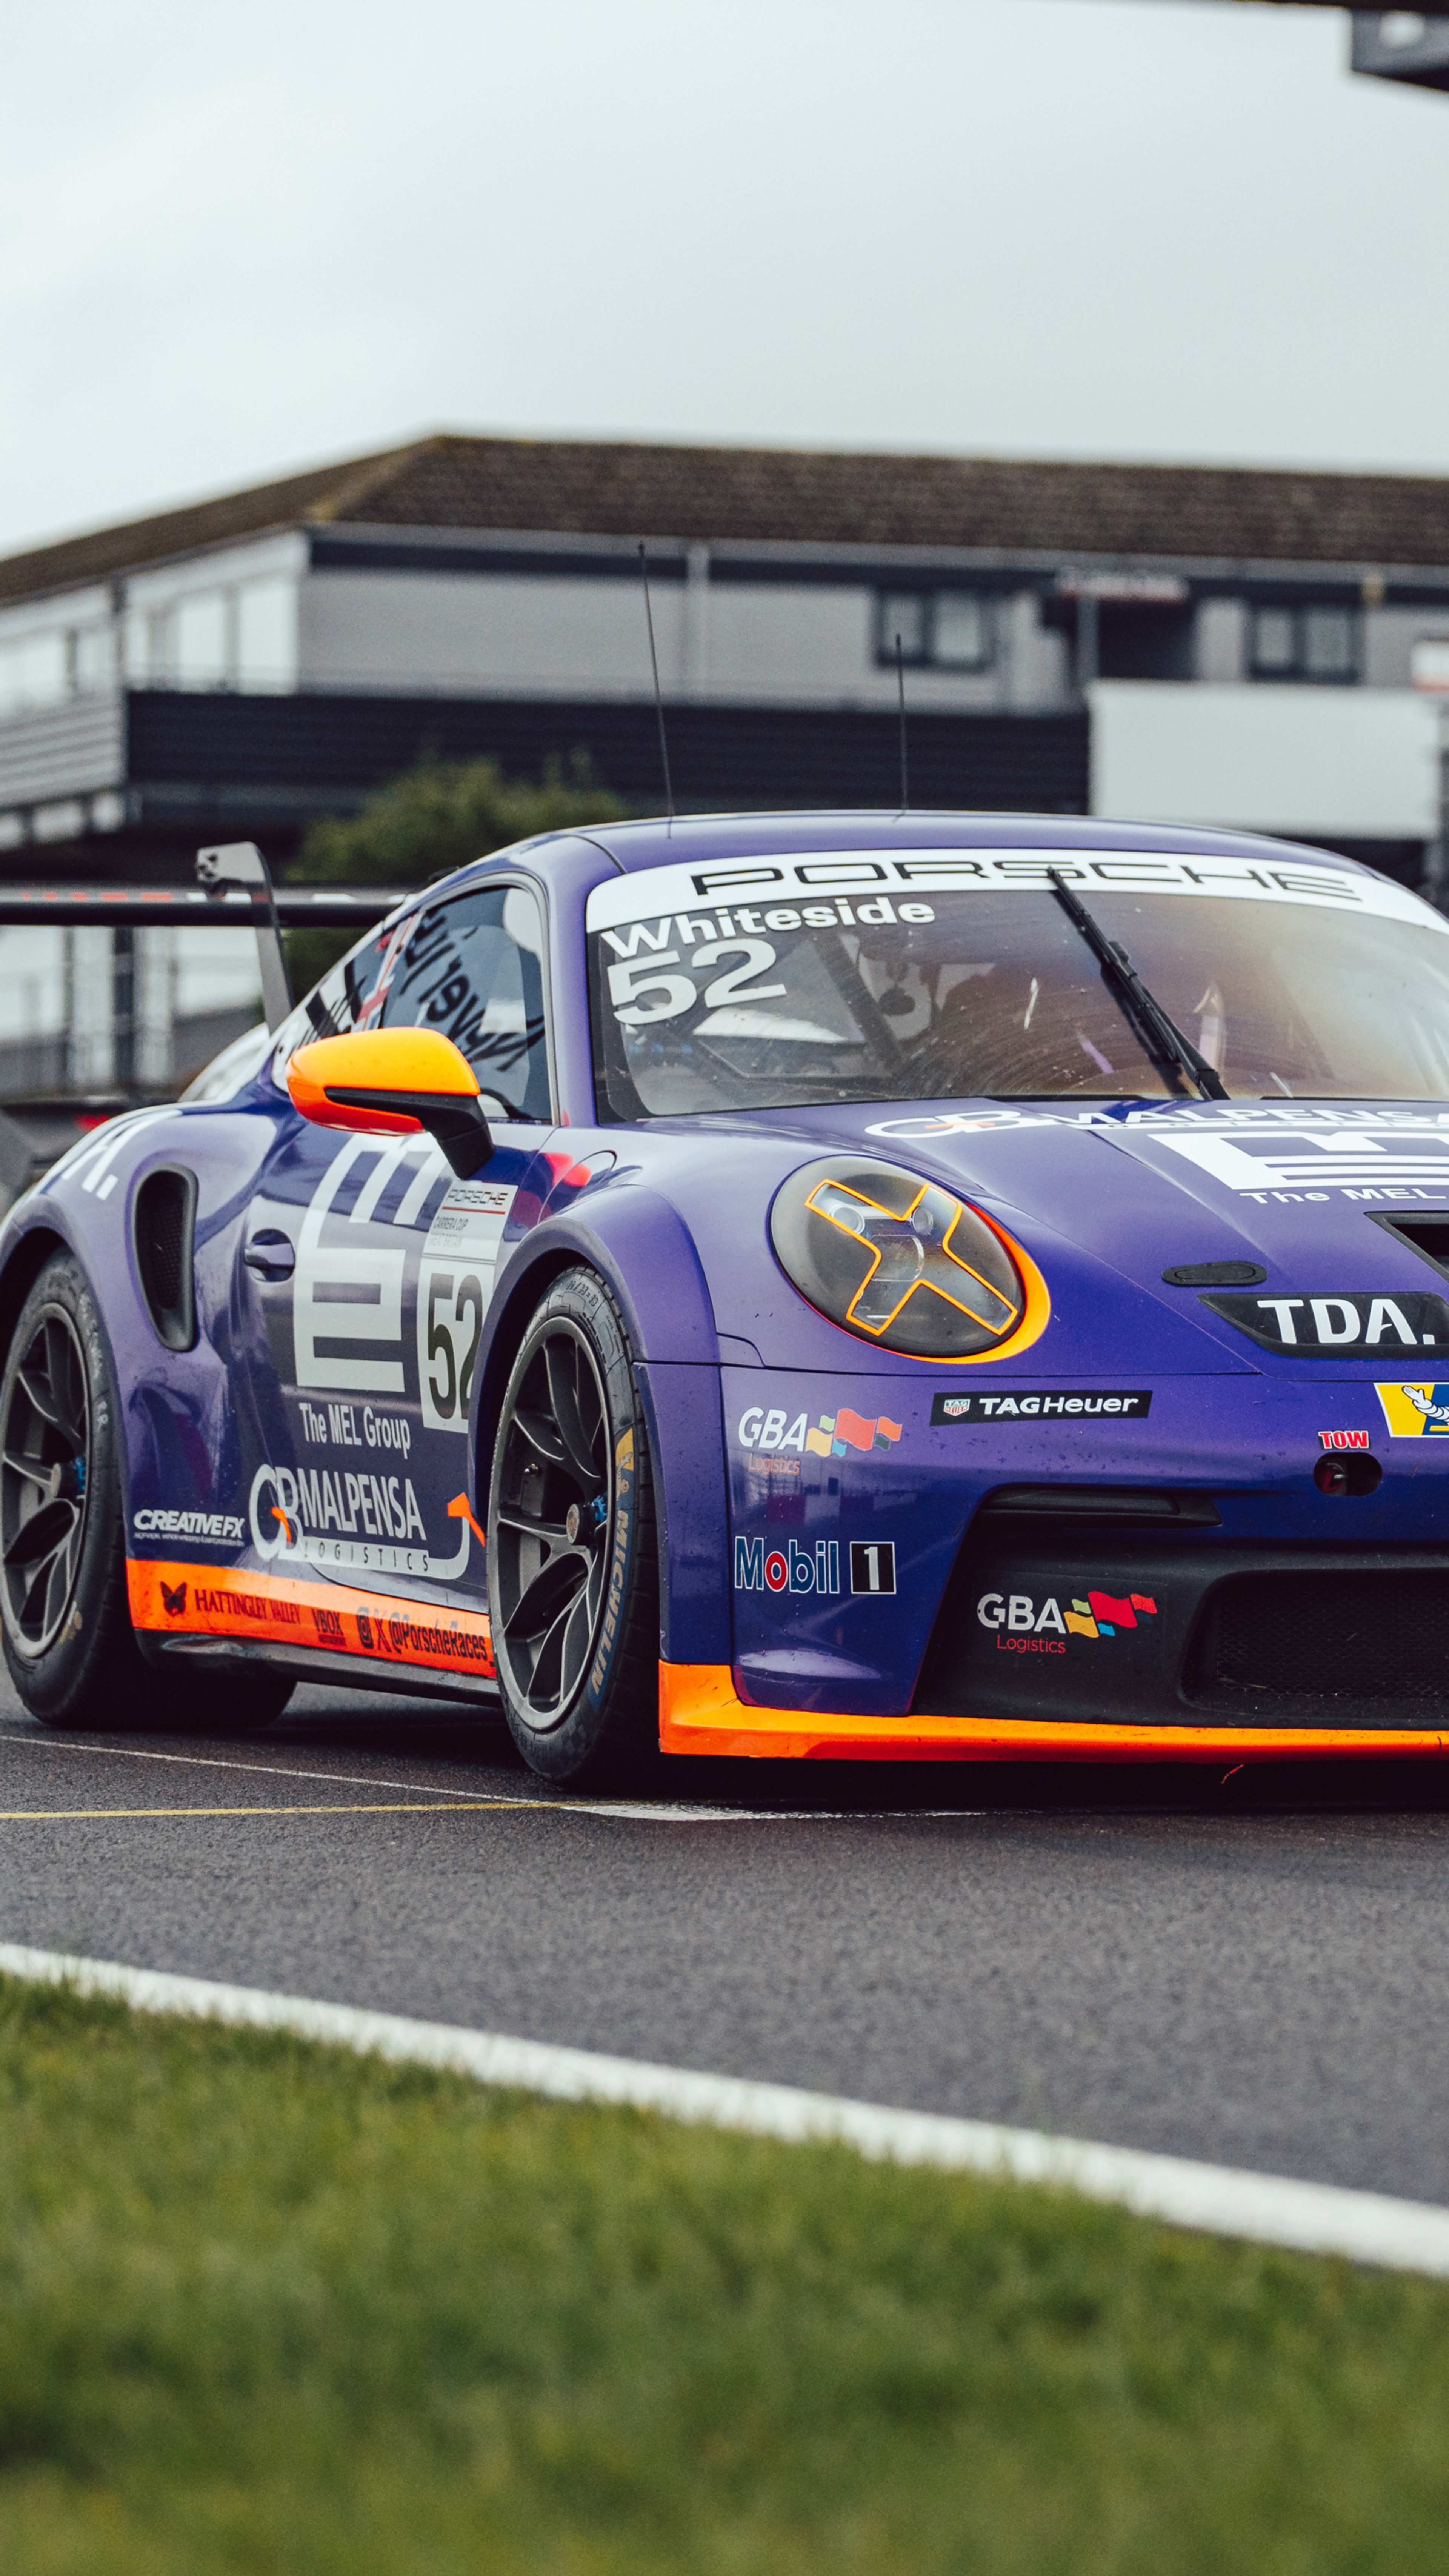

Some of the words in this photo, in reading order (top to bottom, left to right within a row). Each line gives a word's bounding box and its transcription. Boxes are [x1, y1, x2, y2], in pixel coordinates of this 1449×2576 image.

[691, 860, 1363, 902] PORSCHE
[601, 897, 935, 959] Whiteside
[607, 938, 786, 1024] 52
[446, 1189, 508, 1205] PORSCHE
[1240, 1191, 1331, 1204] The
[1341, 1188, 1447, 1200] MEL
[1257, 1299, 1435, 1345] TDA.
[428, 1273, 485, 1419] 52
[299, 1403, 327, 1443] The
[328, 1404, 362, 1446] MEL
[363, 1406, 411, 1459] Group
[738, 1407, 808, 1452] GBA
[1318, 1430, 1369, 1449] TOW
[749, 1452, 800, 1476] Logistics
[298, 1467, 427, 1541] MALPENSA
[305, 1540, 429, 1572] LOGISTICS
[735, 1536, 840, 1594] Mobil
[194, 1589, 268, 1620] HATTINGLEY
[591, 1510, 629, 1696] MICHELIN
[977, 1593, 1067, 1634] GBA
[997, 1635, 1066, 1653] Logistics
